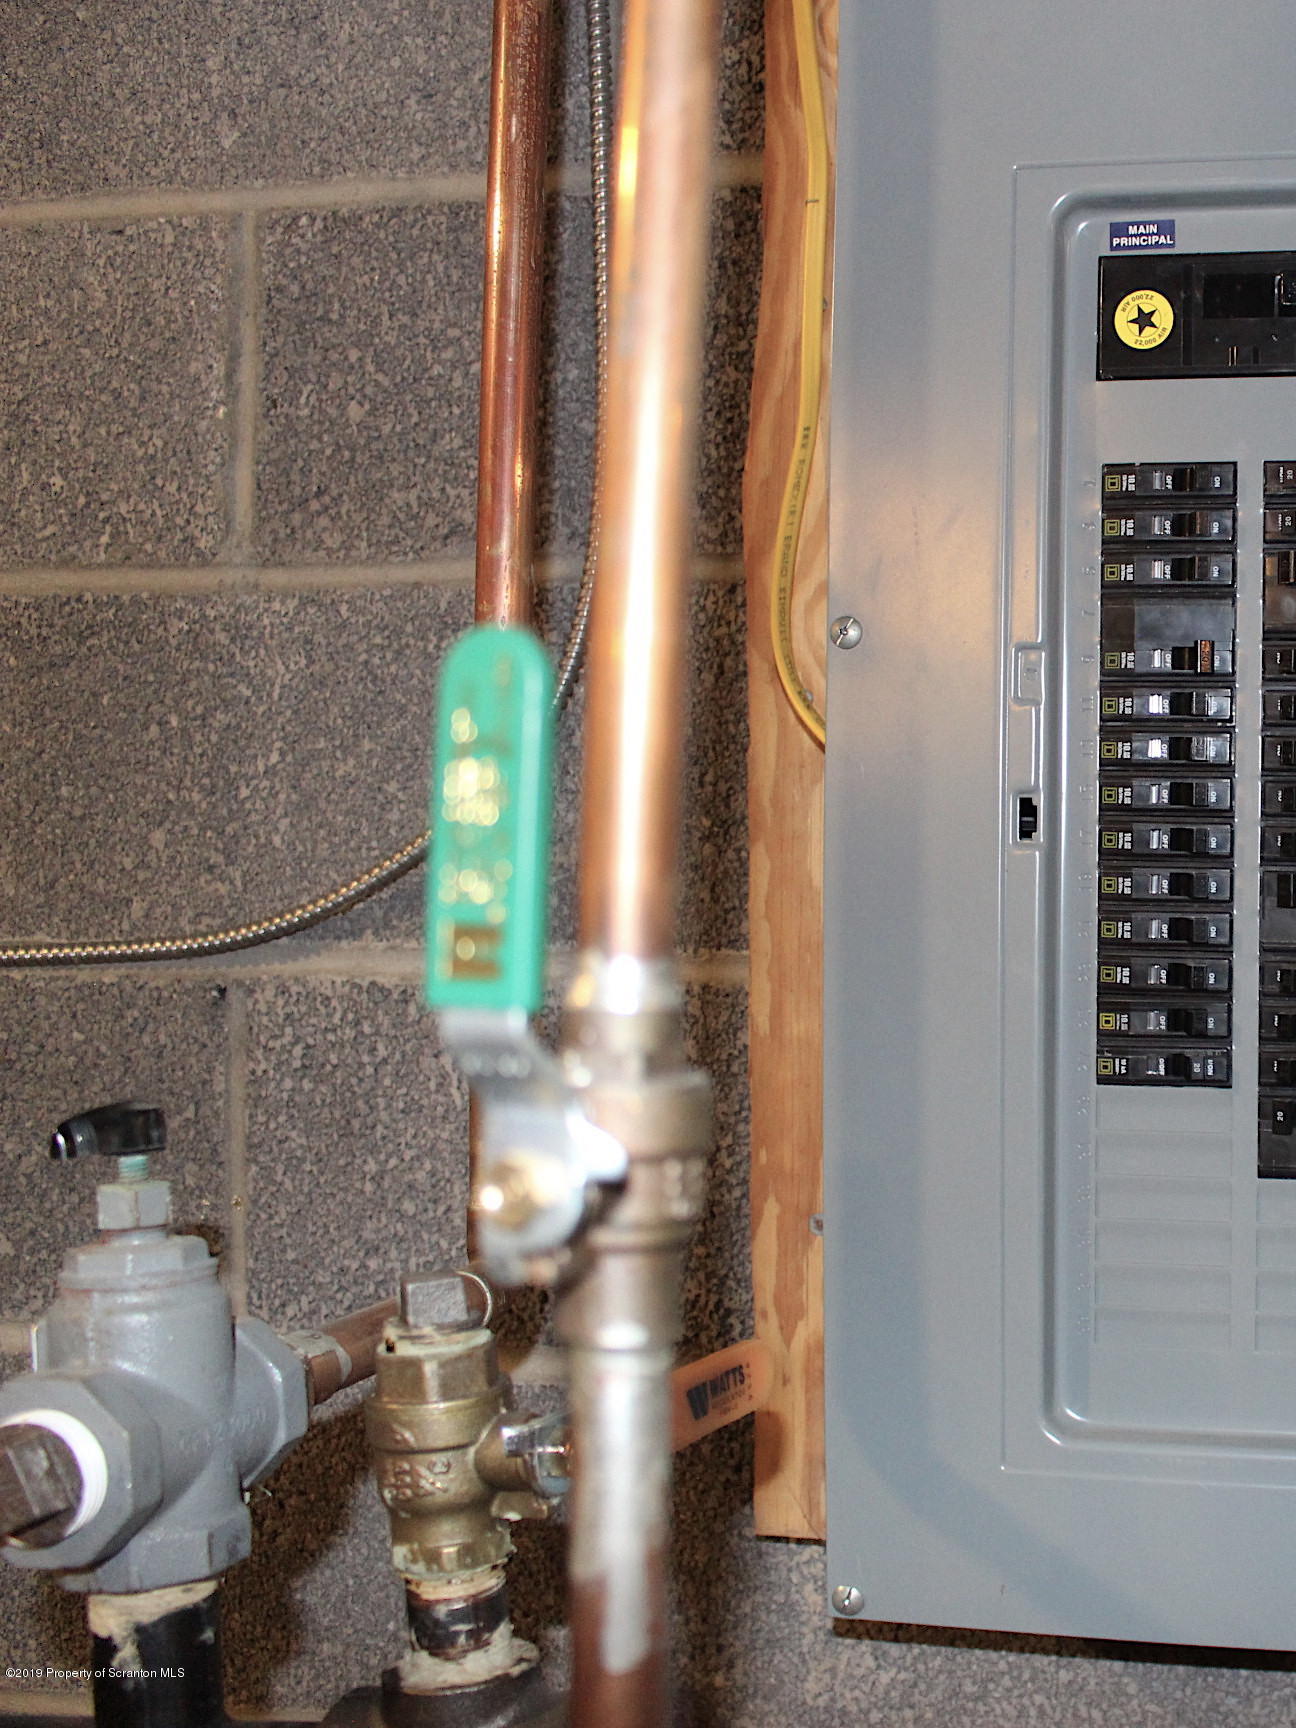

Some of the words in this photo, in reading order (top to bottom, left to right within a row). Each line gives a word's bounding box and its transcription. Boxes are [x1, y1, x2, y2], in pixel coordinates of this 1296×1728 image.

[1128, 224, 1157, 235] MAIN
[1112, 235, 1174, 247] PRINCIPAL
[1287, 469, 1294, 480] 20
[1165, 474, 1173, 490] OFF
[1214, 475, 1221, 488] ON
[1212, 521, 1220, 534] ON
[1285, 515, 1292, 527] 20
[1212, 565, 1220, 577] ON
[1210, 790, 1217, 803] ON
[1210, 836, 1217, 850] ON
[1161, 879, 1169, 894] OFF
[1210, 881, 1217, 893] ON
[1210, 925, 1217, 938] ON
[1208, 972, 1215, 985] ON
[1207, 1017, 1214, 1030] ON
[1193, 1062, 1200, 1073] 20
[1276, 1111, 1284, 1122] 20
